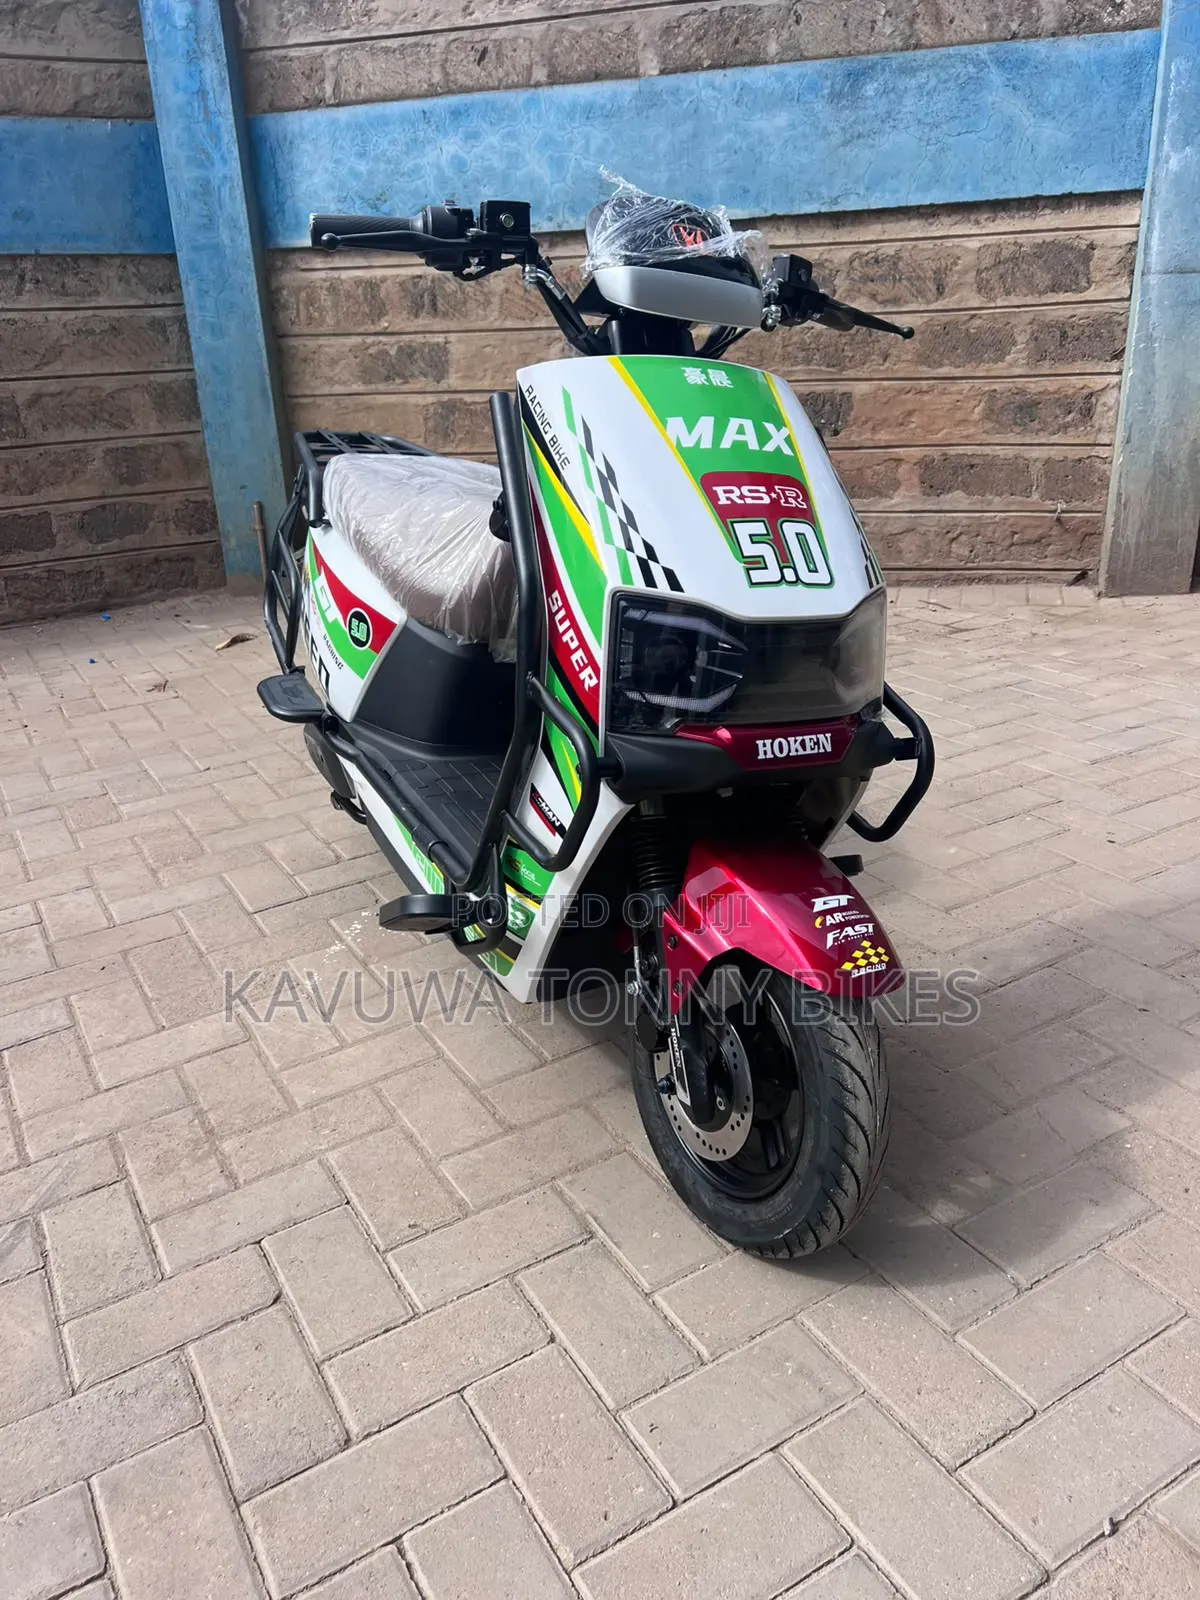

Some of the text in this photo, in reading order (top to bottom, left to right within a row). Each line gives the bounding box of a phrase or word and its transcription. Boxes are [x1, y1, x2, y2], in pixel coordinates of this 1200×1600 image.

[525, 385, 571, 471] RACING BIKE
[664, 416, 794, 456] MAX
[728, 518, 834, 588] 5.0
[548, 589, 599, 692] SUPER
[756, 733, 833, 760] HOKEN
[811, 894, 855, 913] GT
[826, 923, 875, 950] FAST
[851, 962, 887, 978] RACING
